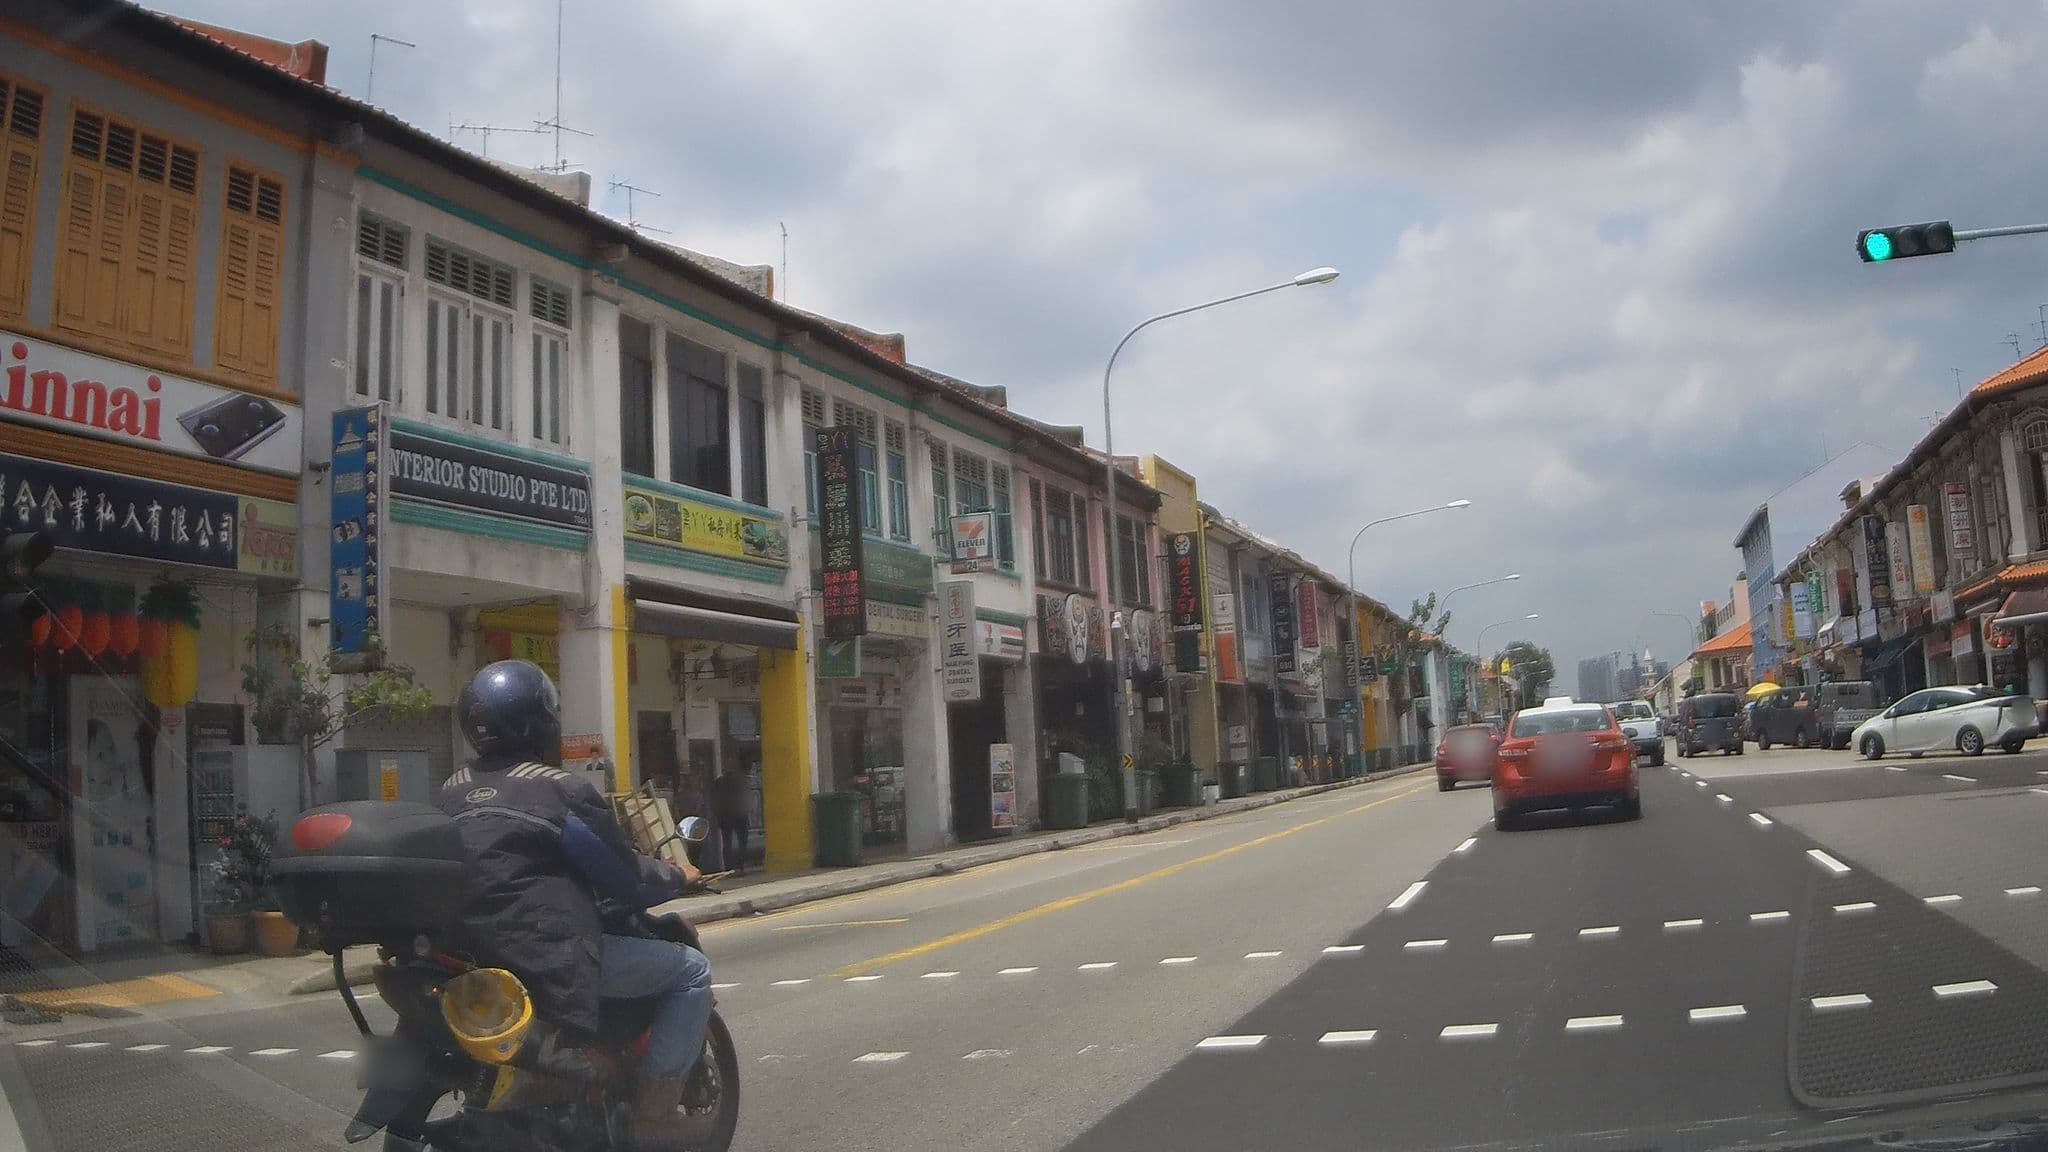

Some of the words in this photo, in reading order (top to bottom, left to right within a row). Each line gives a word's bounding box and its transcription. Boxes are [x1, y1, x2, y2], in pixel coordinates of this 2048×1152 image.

[0, 341, 161, 440] innai
[0, 474, 233, 550] 合企業私人有限公司
[390, 448, 465, 490] NTERIOR
[469, 465, 526, 502] STUDIO
[530, 478, 558, 508] PTE
[562, 485, 587, 513] LTD
[967, 561, 978, 571] 24
[1848, 712, 1873, 721] TOYO
